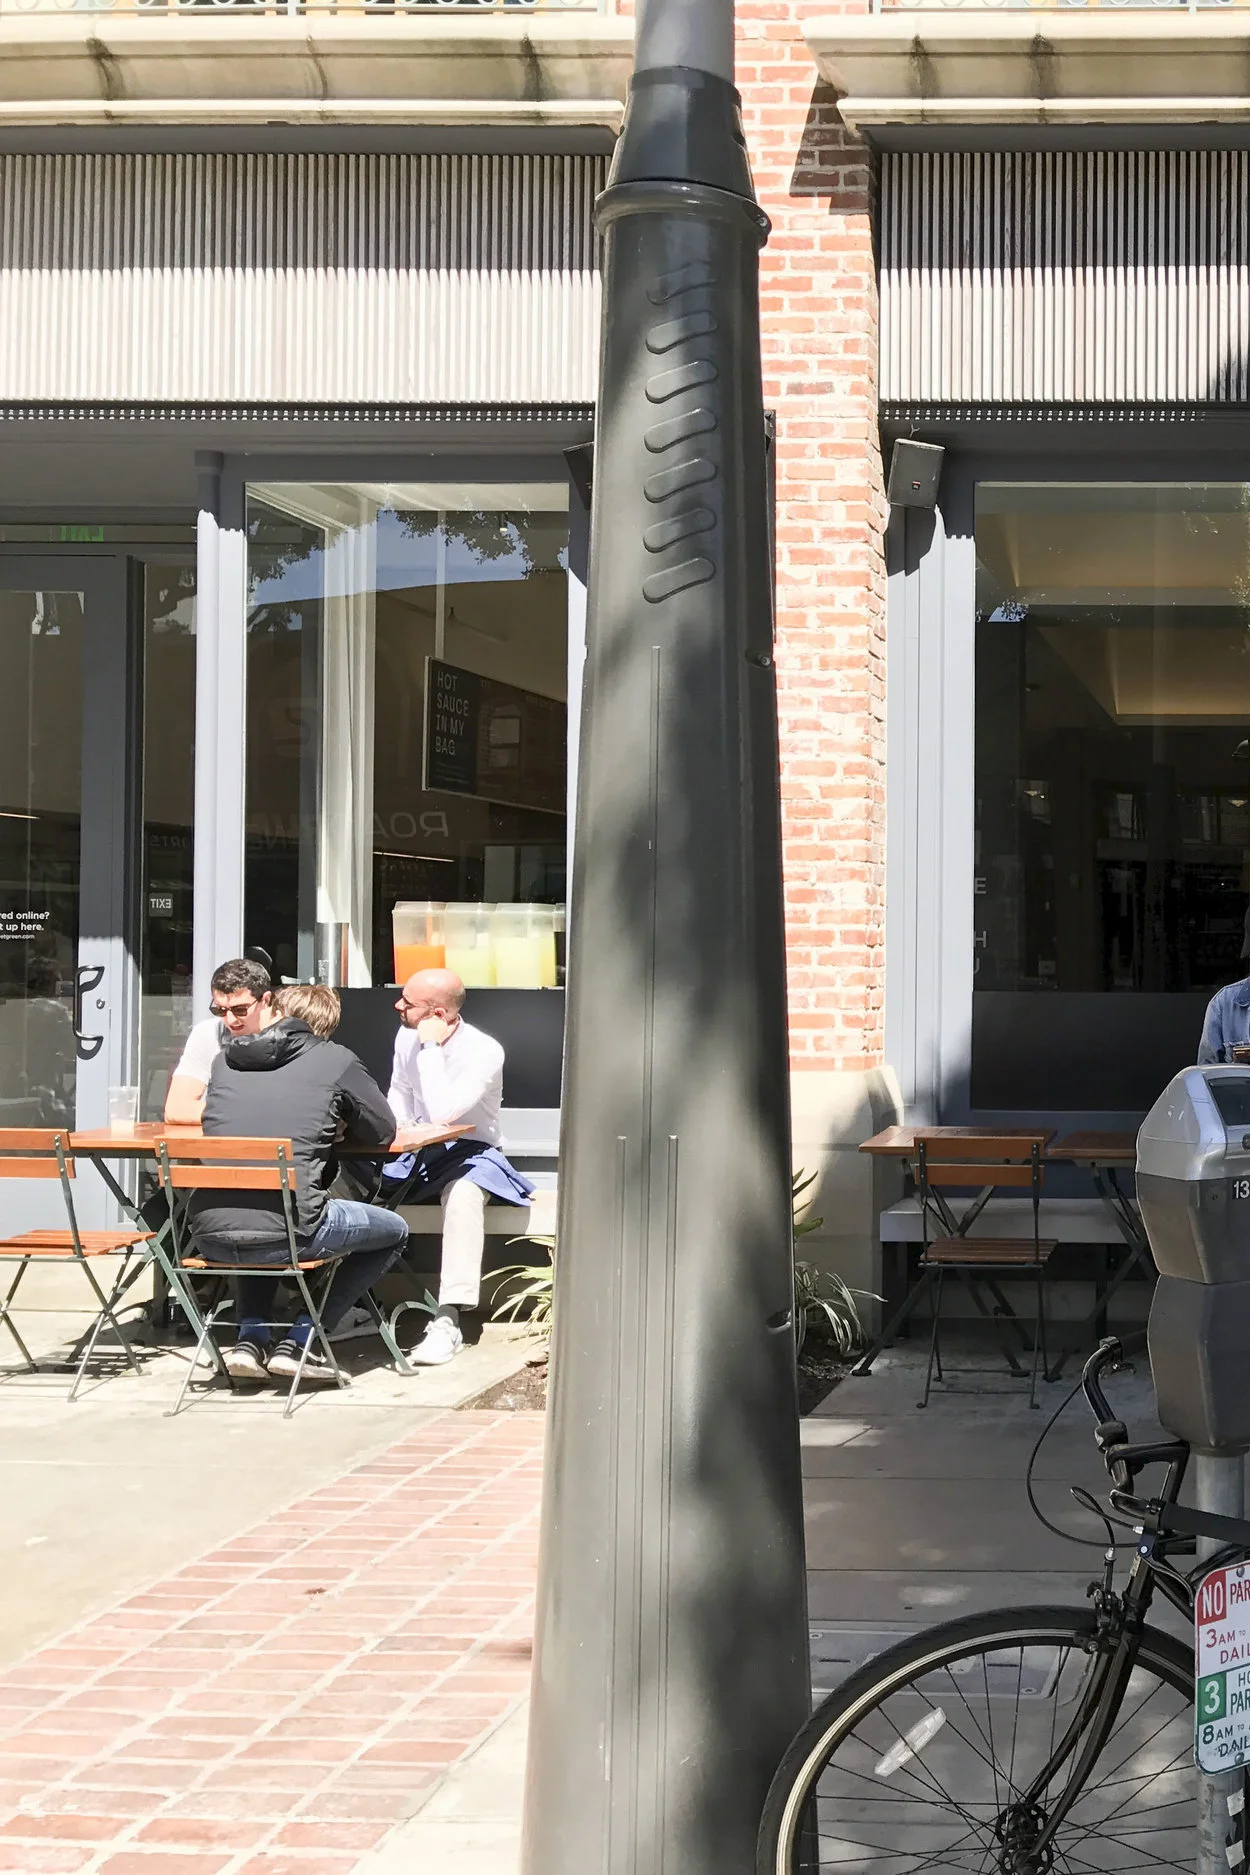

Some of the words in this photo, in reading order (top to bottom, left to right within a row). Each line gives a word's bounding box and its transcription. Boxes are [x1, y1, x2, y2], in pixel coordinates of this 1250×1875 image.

[437, 671, 458, 692] HOT
[436, 692, 470, 717] SAUCE
[435, 714, 447, 732] IN
[450, 718, 465, 737] MY
[435, 736, 456, 757] BAG
[15, 911, 50, 920] online?
[5, 923, 19, 932] up
[20, 922, 44, 931] here.
[1202, 1581, 1224, 1619] NO
[1206, 1628, 1236, 1648] 3AM
[1204, 1680, 1220, 1714] 3
[1202, 1724, 1234, 1745] 8AM
